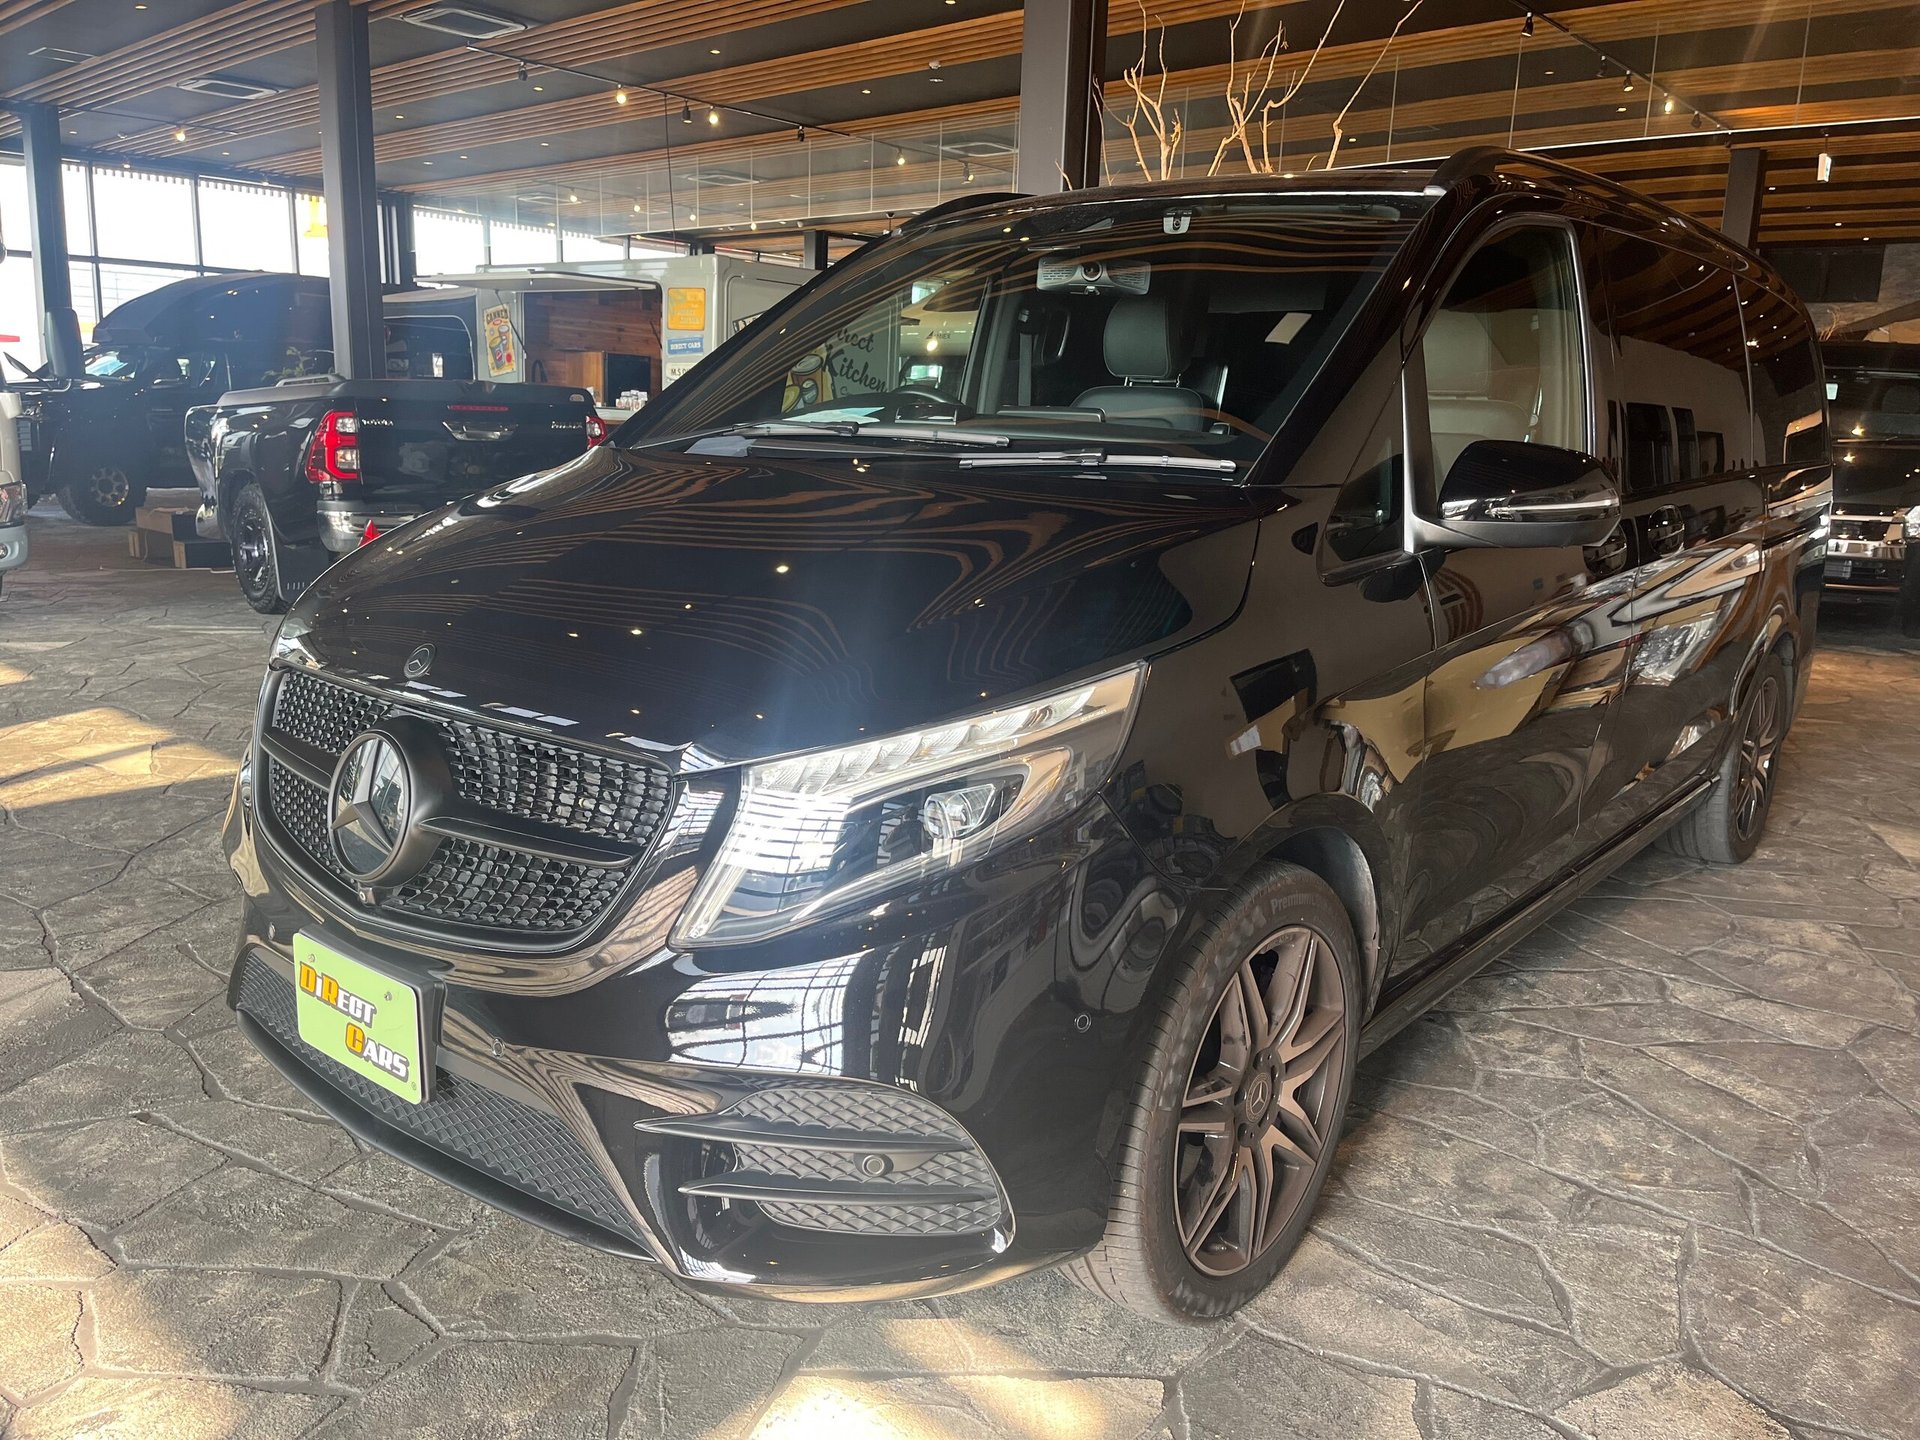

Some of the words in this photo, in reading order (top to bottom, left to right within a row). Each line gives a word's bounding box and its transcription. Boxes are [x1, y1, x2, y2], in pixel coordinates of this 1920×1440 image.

[836, 327, 875, 353] irect
[822, 344, 888, 394] Kitchen
[345, 1022, 410, 1083] CARS
